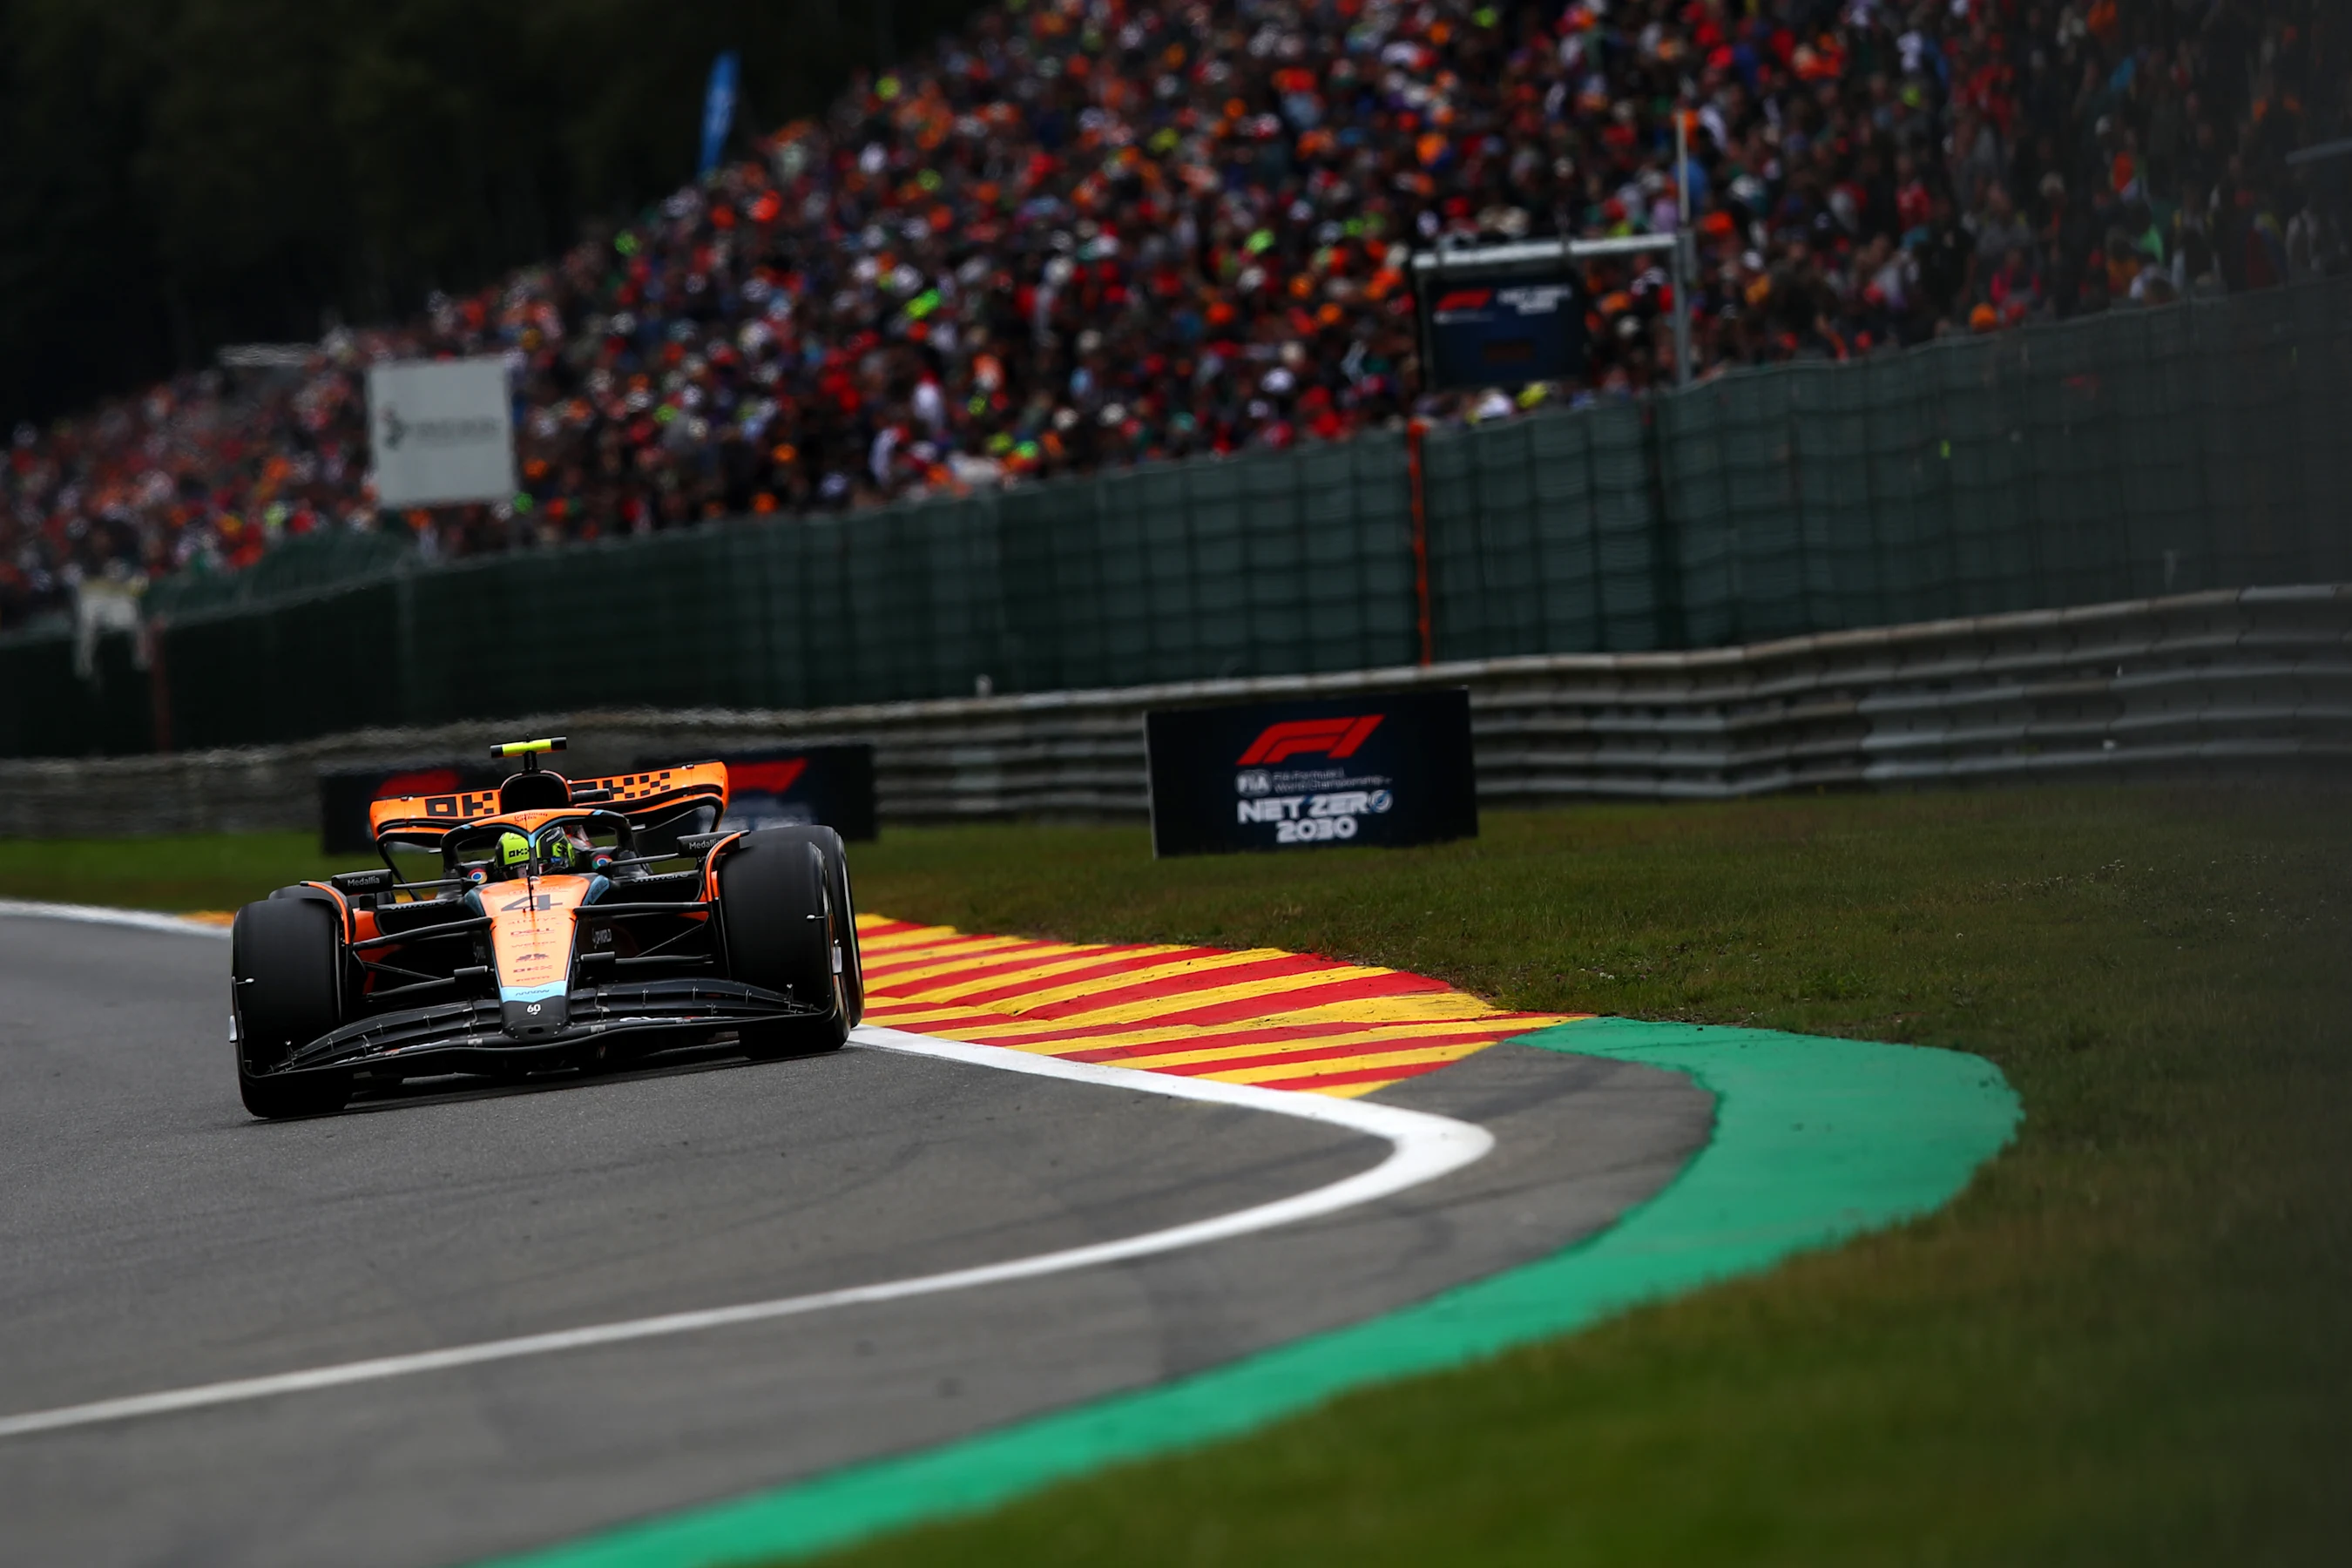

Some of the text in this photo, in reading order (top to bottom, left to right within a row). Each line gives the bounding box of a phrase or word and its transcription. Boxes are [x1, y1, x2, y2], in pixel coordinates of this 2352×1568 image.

[426, 792, 495, 816] OK
[1237, 789, 1394, 825] NET ZERO
[1275, 815, 1358, 843] 2030
[347, 875, 381, 888] Medallia
[501, 895, 564, 911] 4
[526, 1003, 541, 1013] 60
